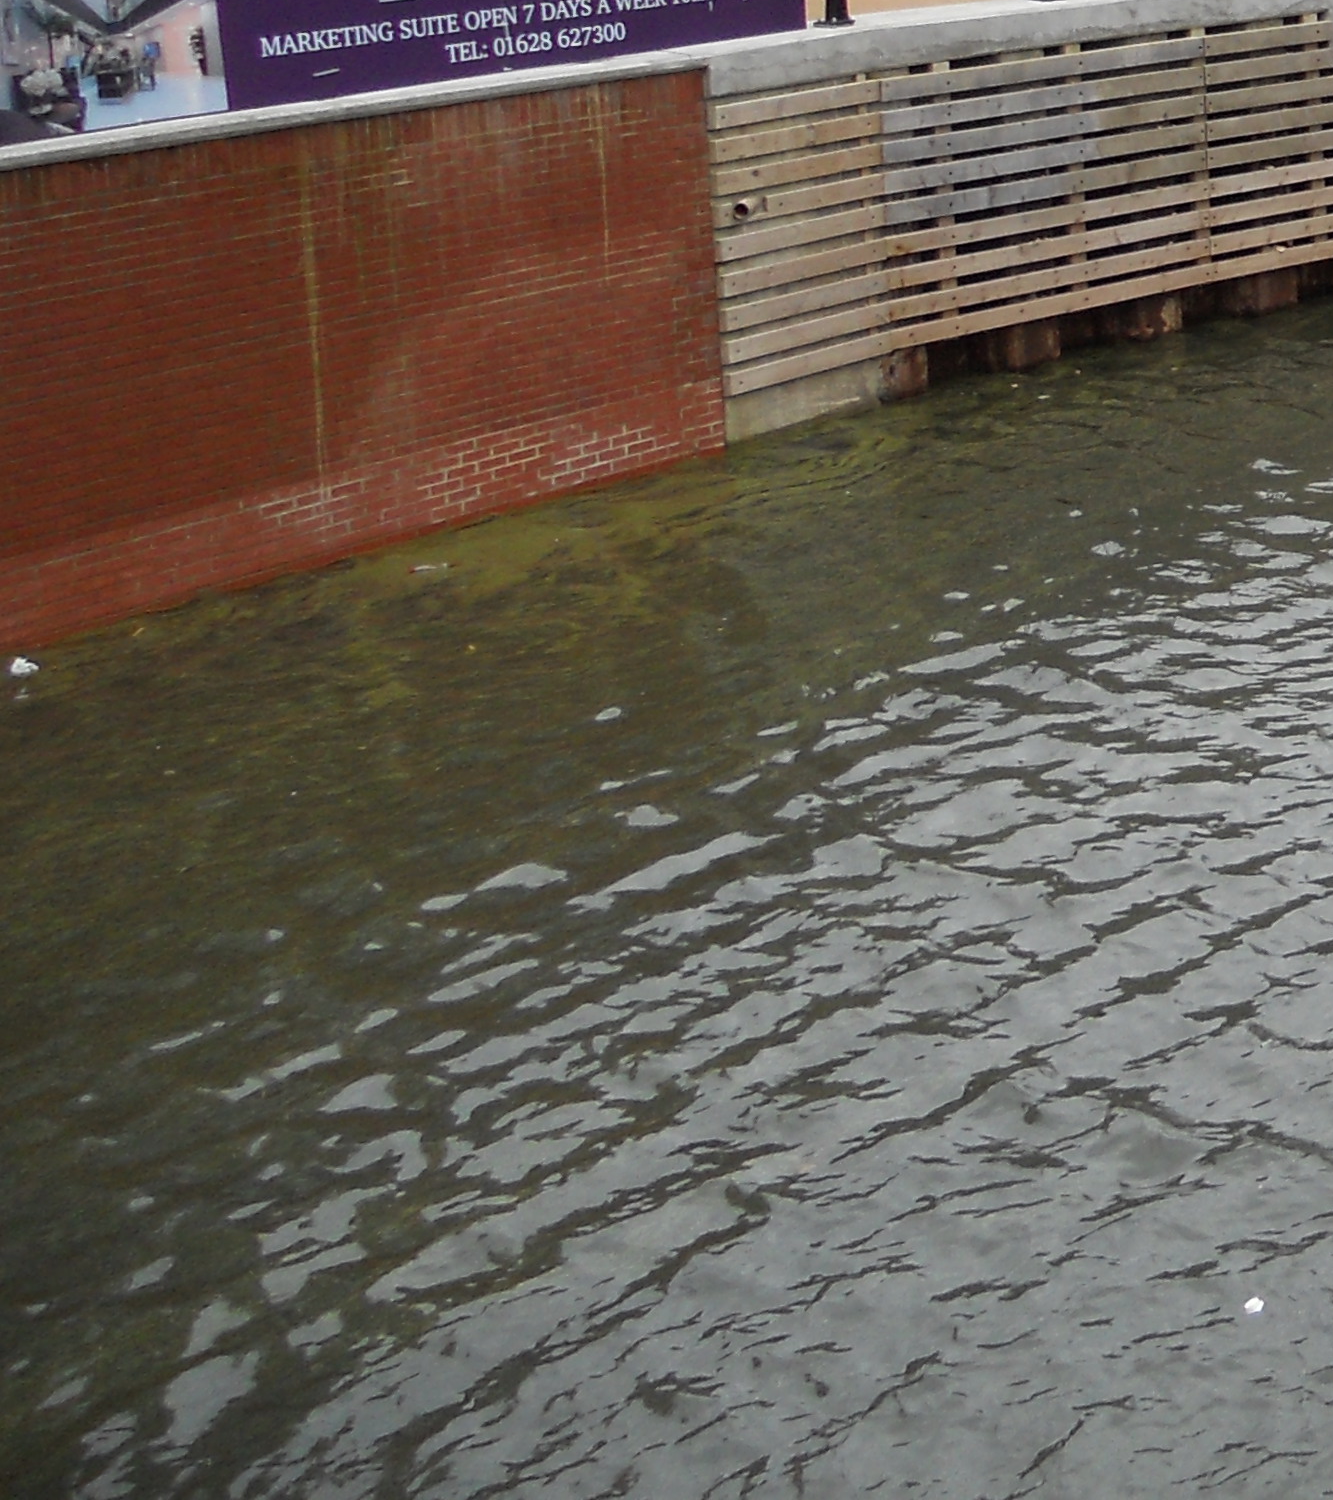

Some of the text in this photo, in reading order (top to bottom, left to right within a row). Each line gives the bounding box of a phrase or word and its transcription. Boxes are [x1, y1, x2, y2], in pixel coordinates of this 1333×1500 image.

[260, 21, 394, 58] MARKETING
[400, 13, 460, 40] SUITE
[464, 5, 518, 32] OPEN
[523, 4, 535, 24] 7
[445, 22, 627, 63] TEL: 01628 627300
